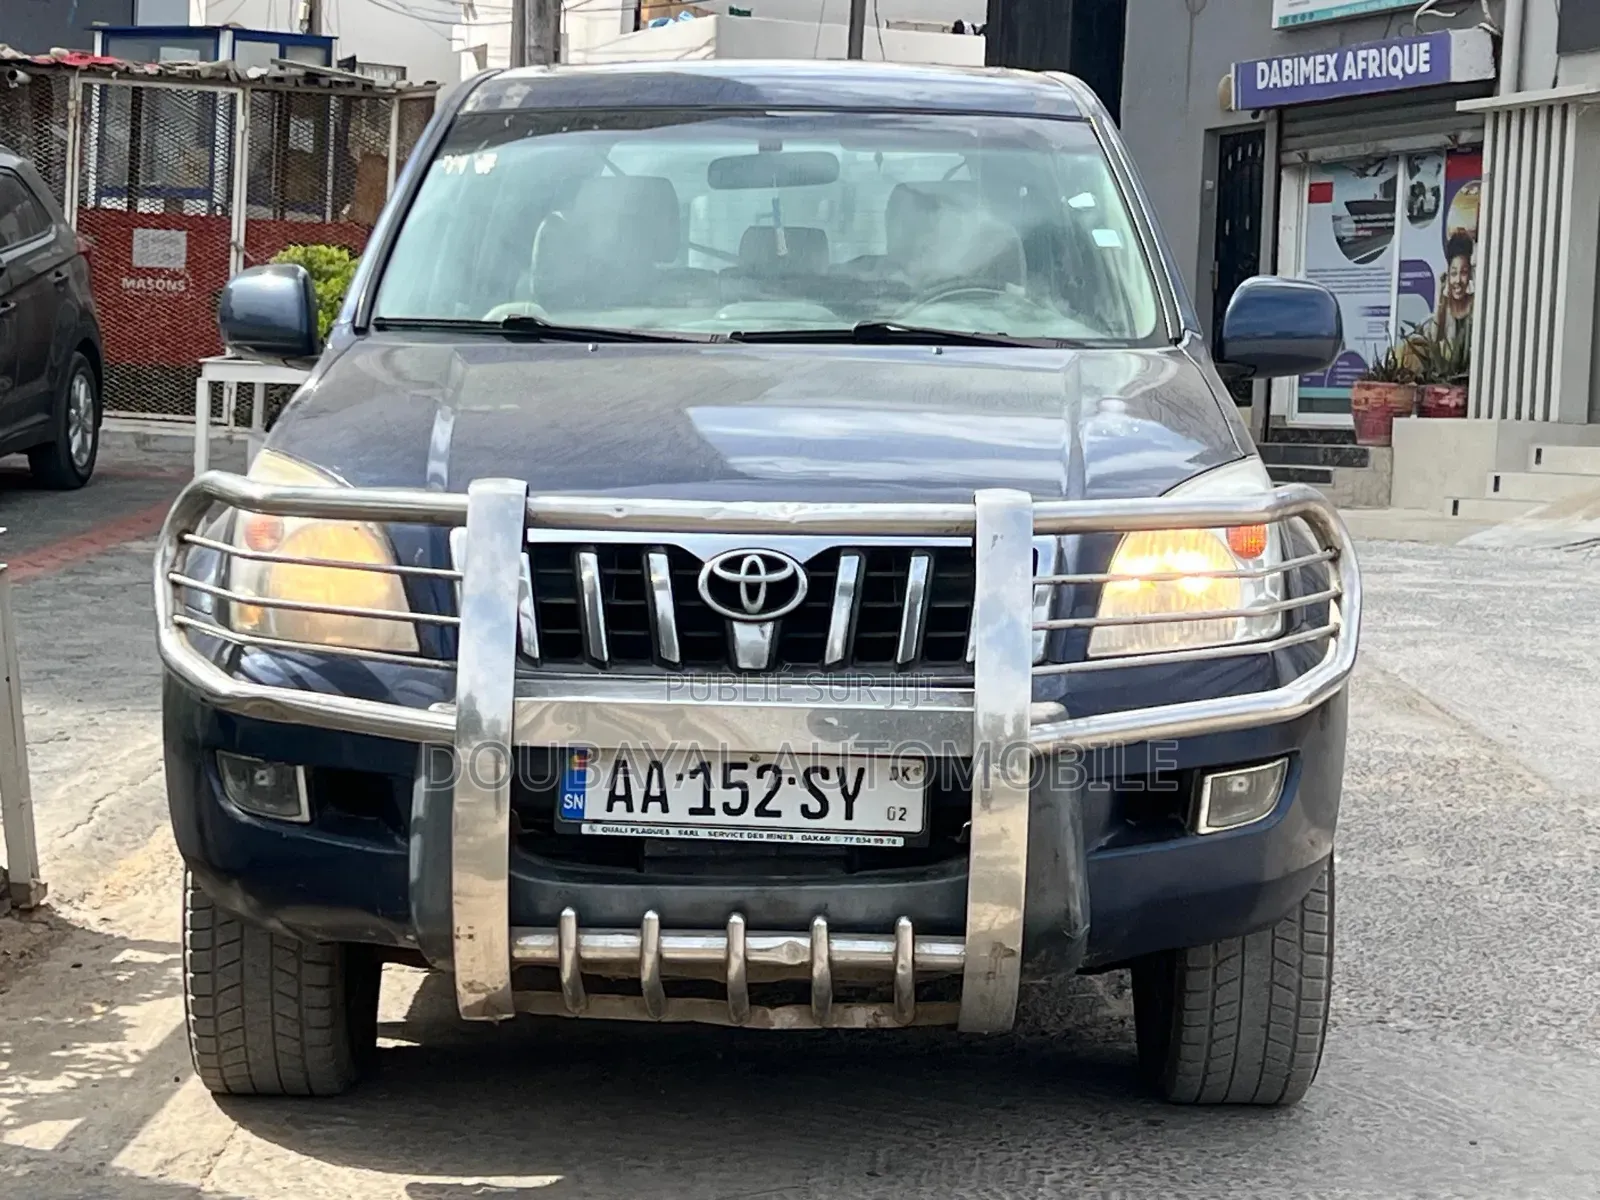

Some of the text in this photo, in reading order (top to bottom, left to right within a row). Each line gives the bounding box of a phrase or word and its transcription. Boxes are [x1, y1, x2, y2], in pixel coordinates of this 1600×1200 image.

[1256, 42, 1431, 90] DABIMEX AFRIQUE
[563, 793, 585, 810] SN
[707, 830, 745, 839] SERVICE
[801, 834, 831, 843] DAKAR
